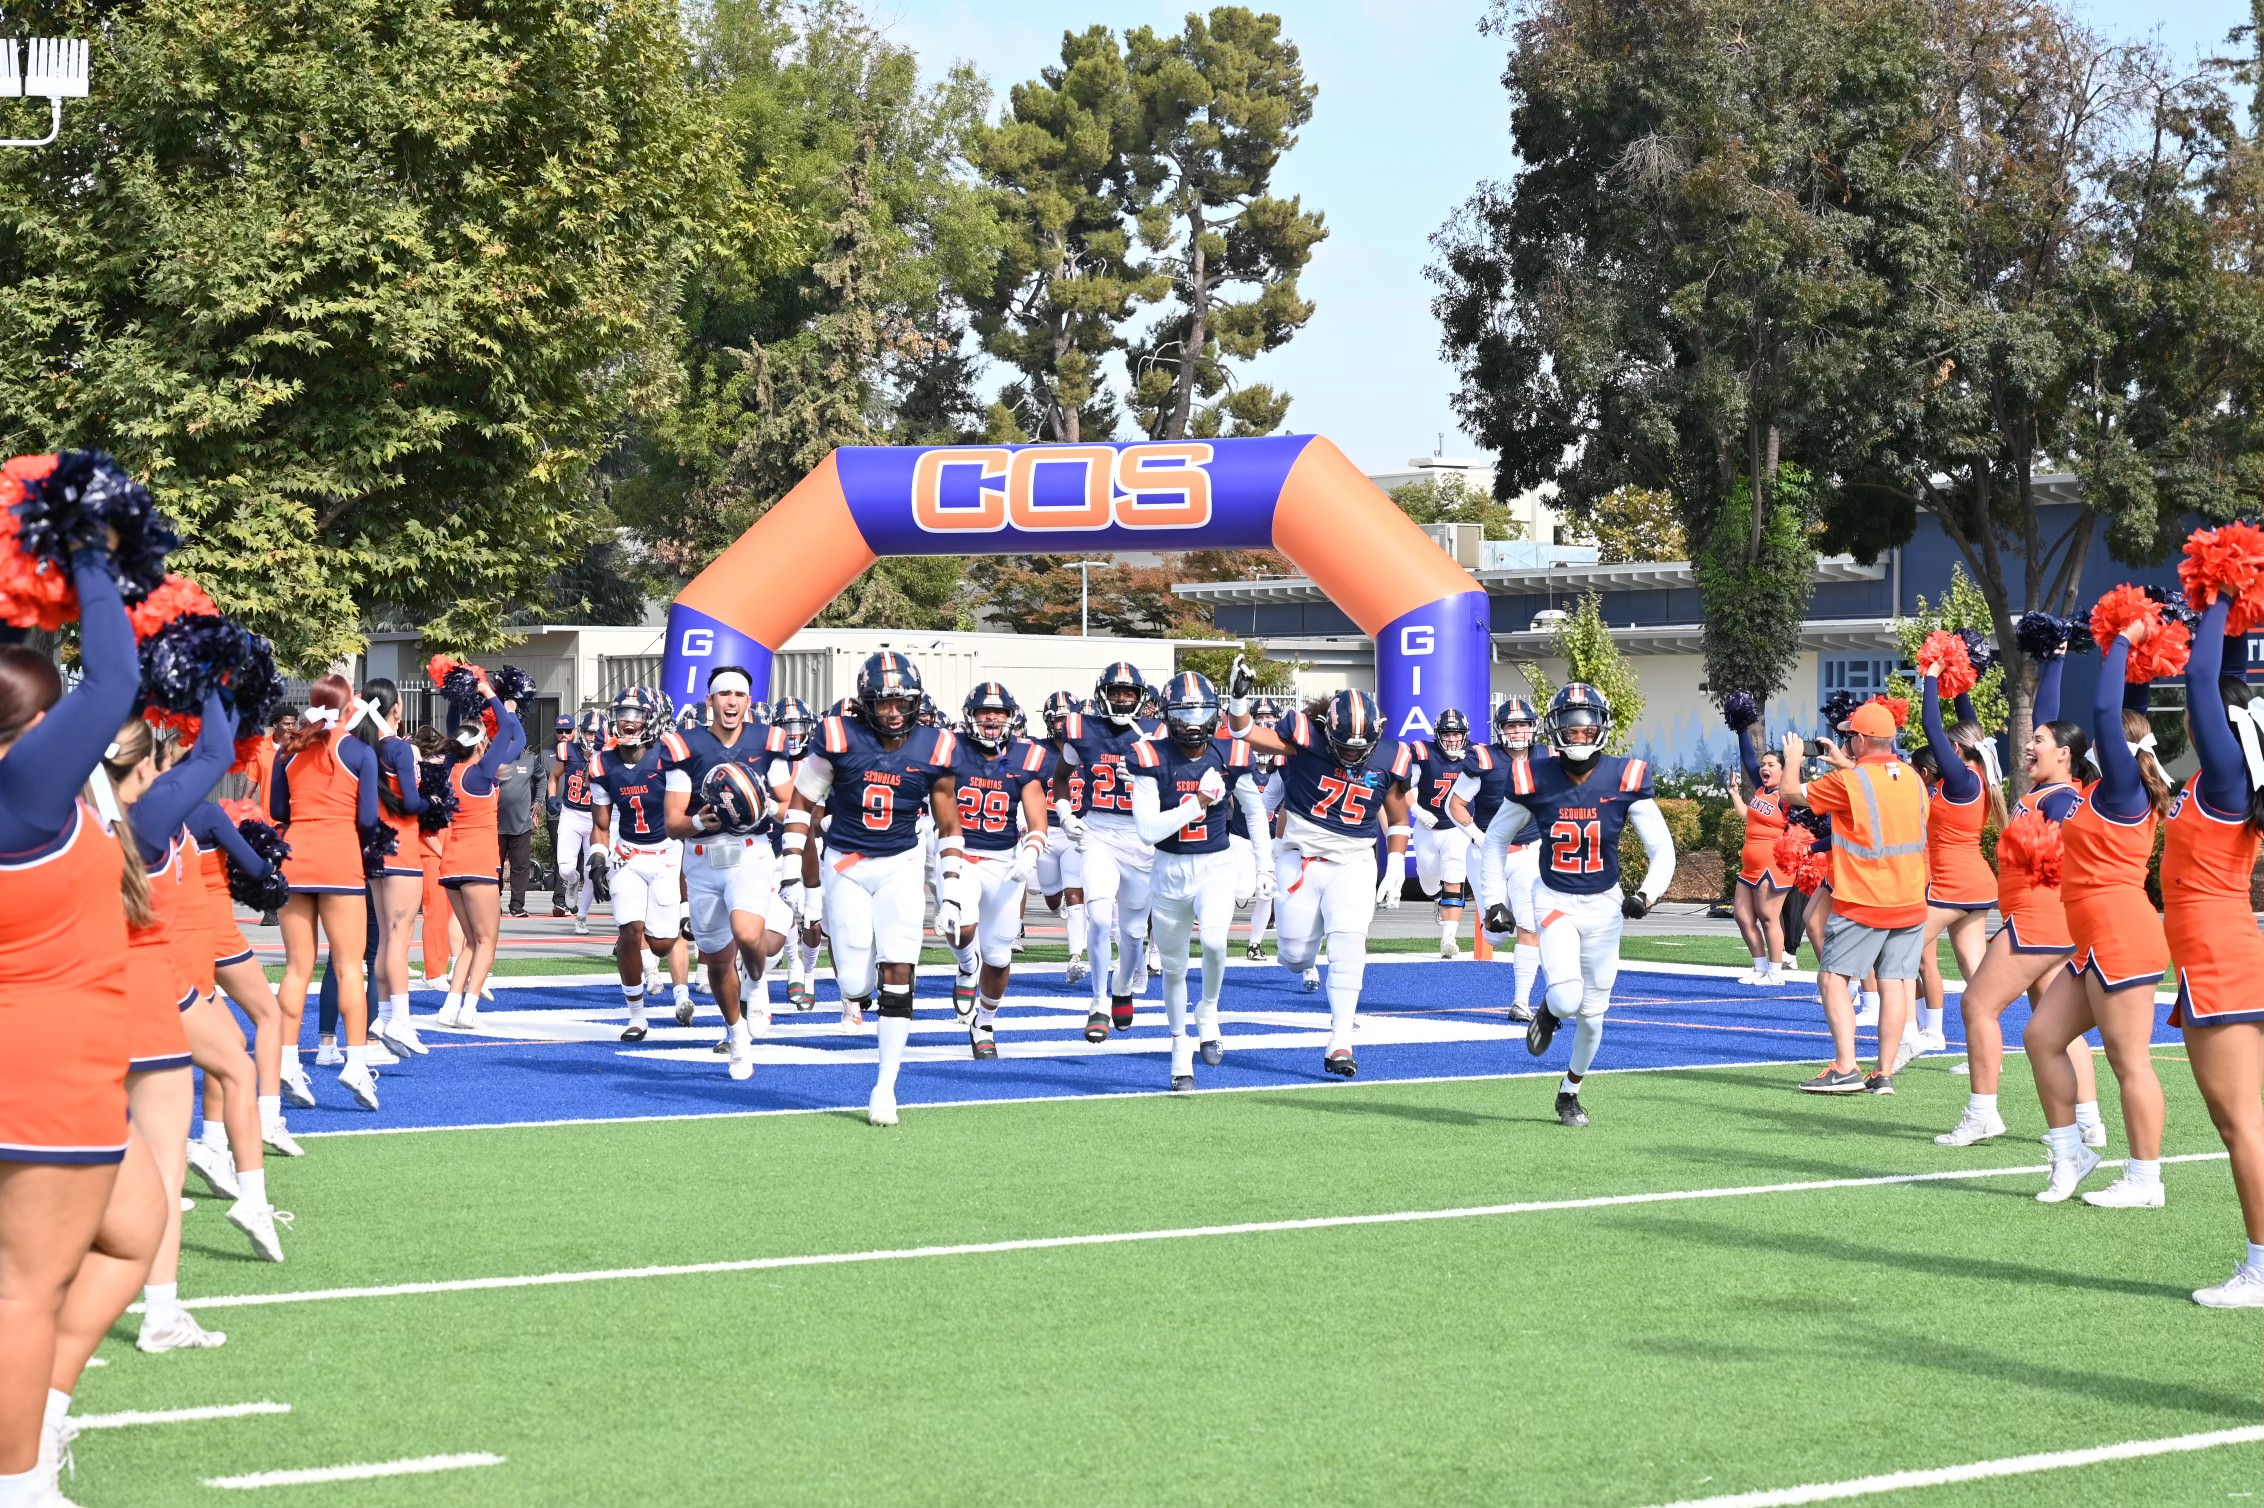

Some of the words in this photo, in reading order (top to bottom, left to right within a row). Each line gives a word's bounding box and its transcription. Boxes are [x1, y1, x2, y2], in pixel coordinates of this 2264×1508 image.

[911, 443, 1215, 534] COS
[1398, 625, 1435, 737] GIA
[863, 770, 902, 787] SEQUOIAS
[969, 776, 1003, 791] SEQUOIAS
[1311, 775, 1374, 825] 75
[628, 795, 651, 834] 1
[862, 783, 895, 831] 9
[957, 785, 1010, 833] 29
[1558, 807, 1598, 820] SEQUOIAS
[1549, 820, 1604, 874] 21
